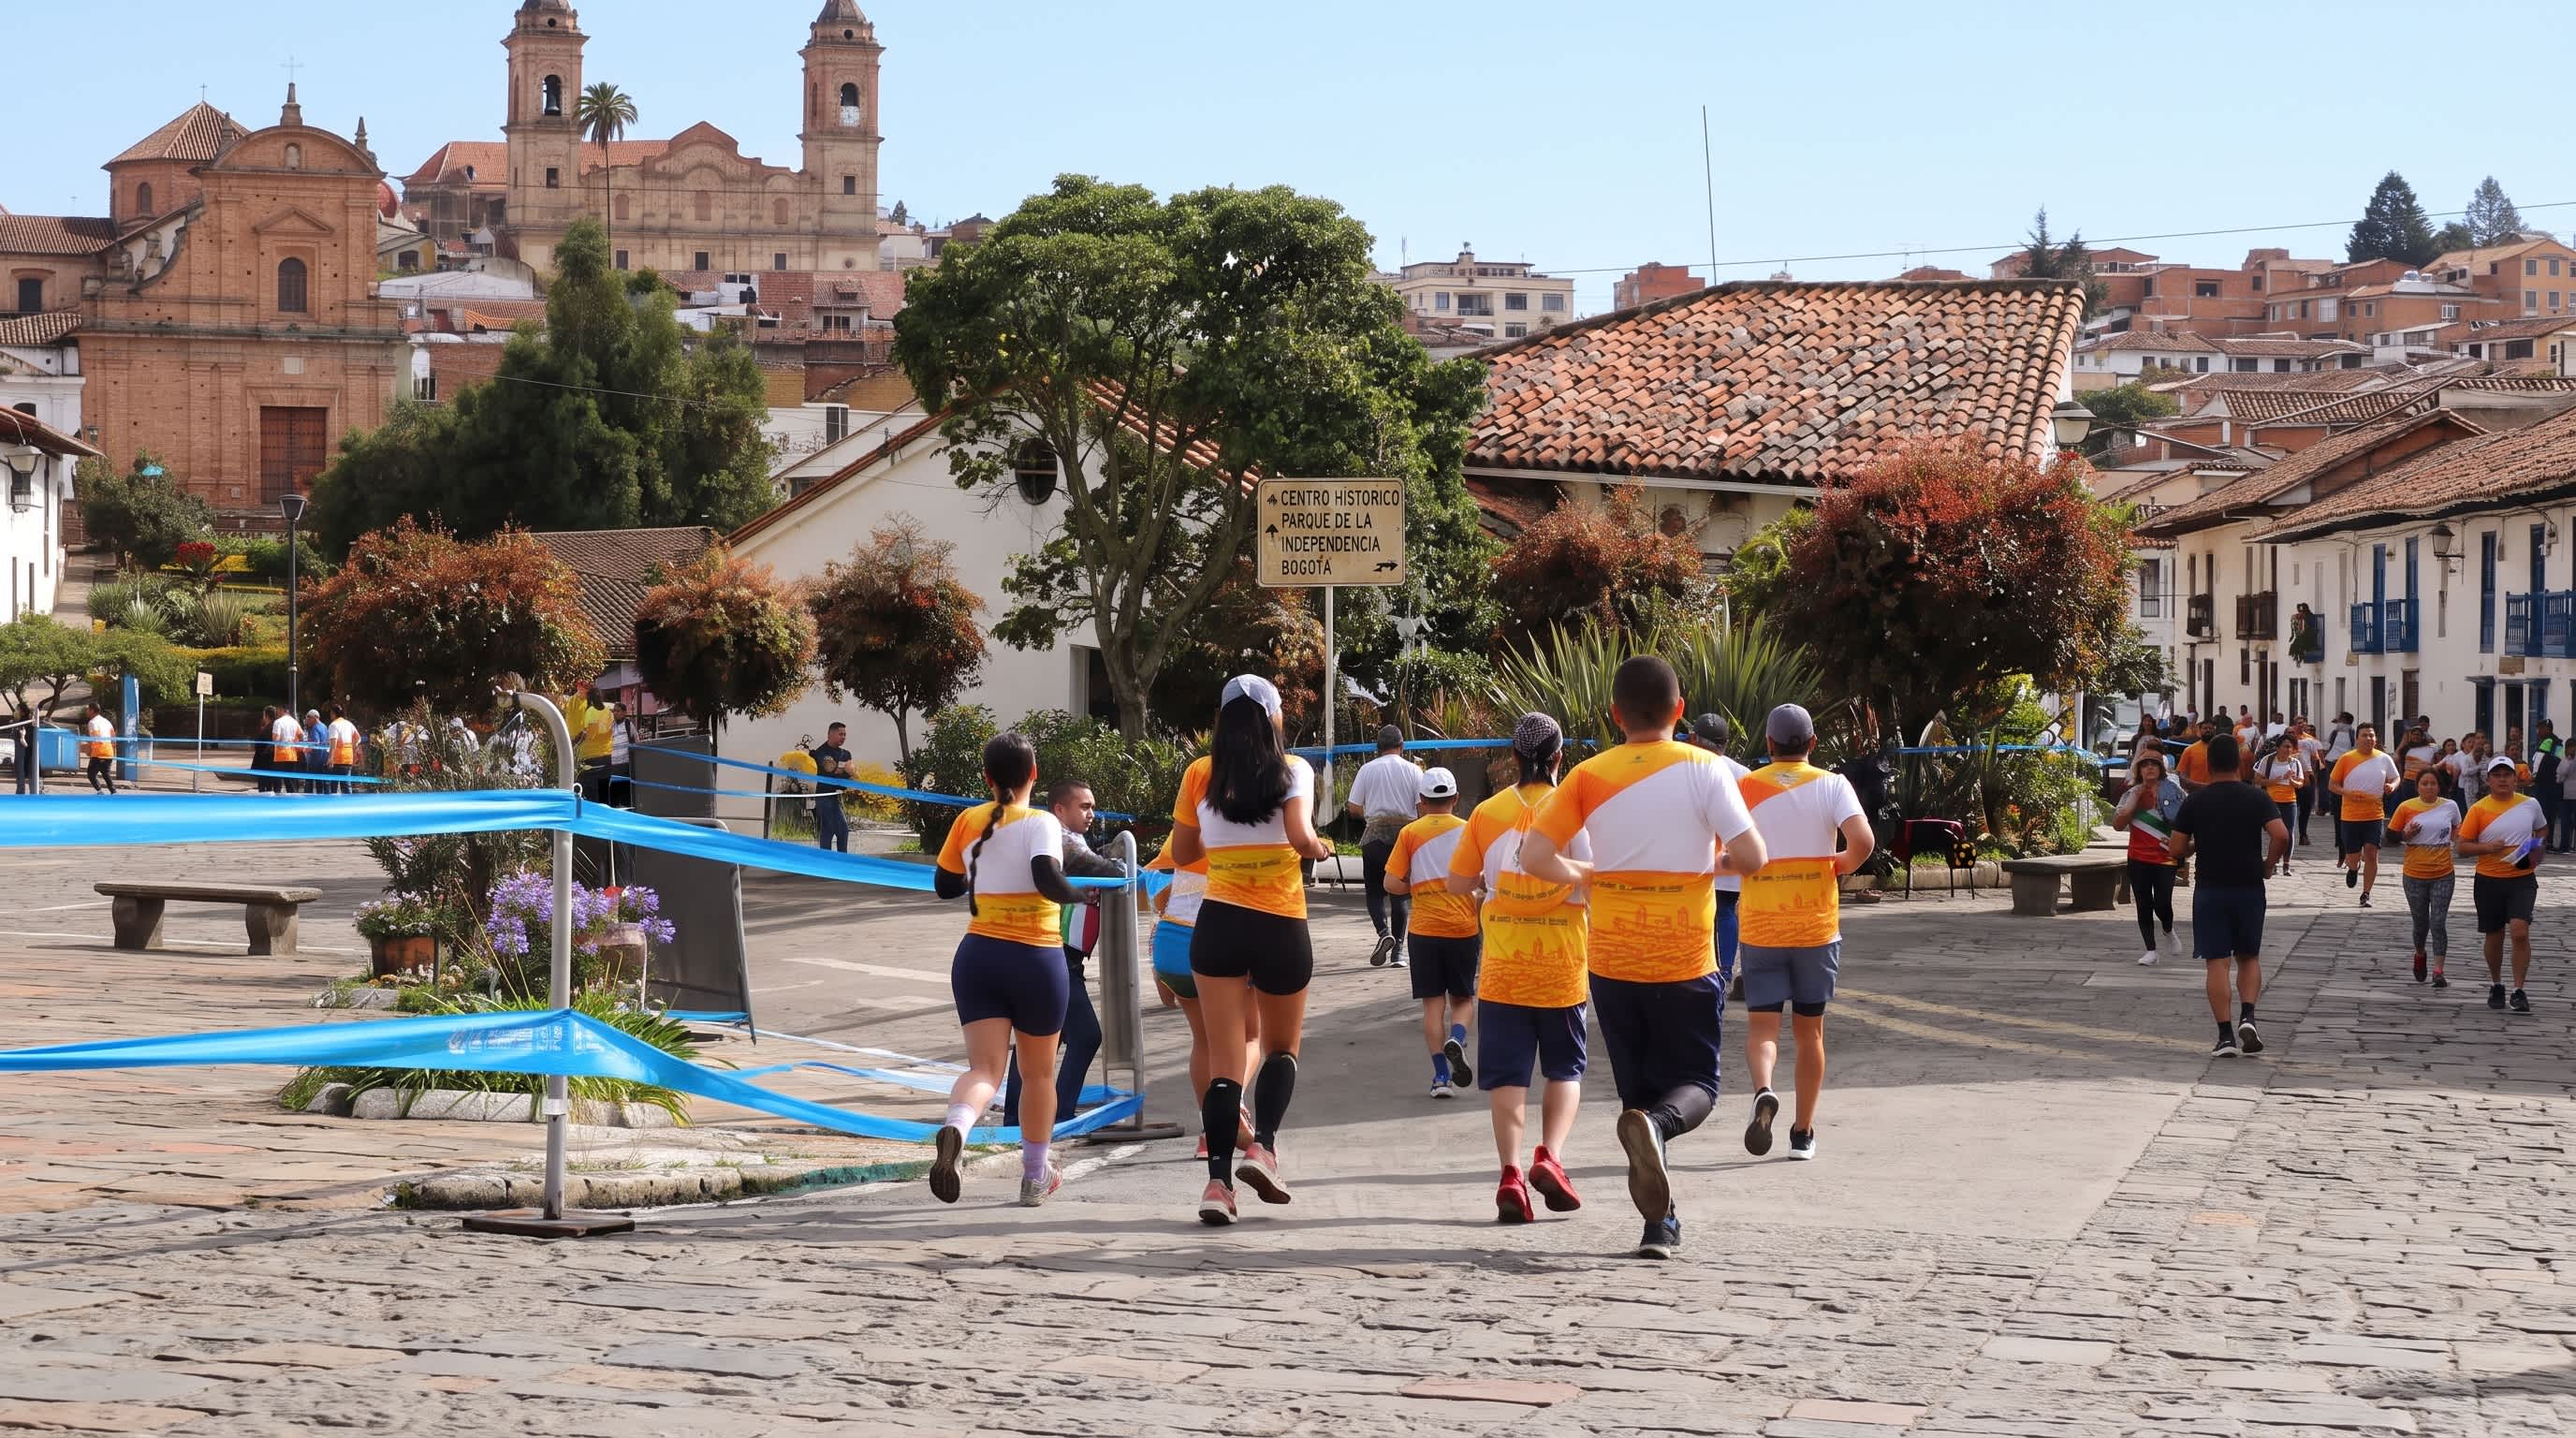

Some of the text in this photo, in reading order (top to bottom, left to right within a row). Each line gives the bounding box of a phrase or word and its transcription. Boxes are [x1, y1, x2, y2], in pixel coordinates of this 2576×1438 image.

[1281, 490, 1330, 506] CENTRO
[1281, 512, 1372, 530] PARQUE DE LA
[1281, 536, 1381, 552] INDEPENDENCIA
